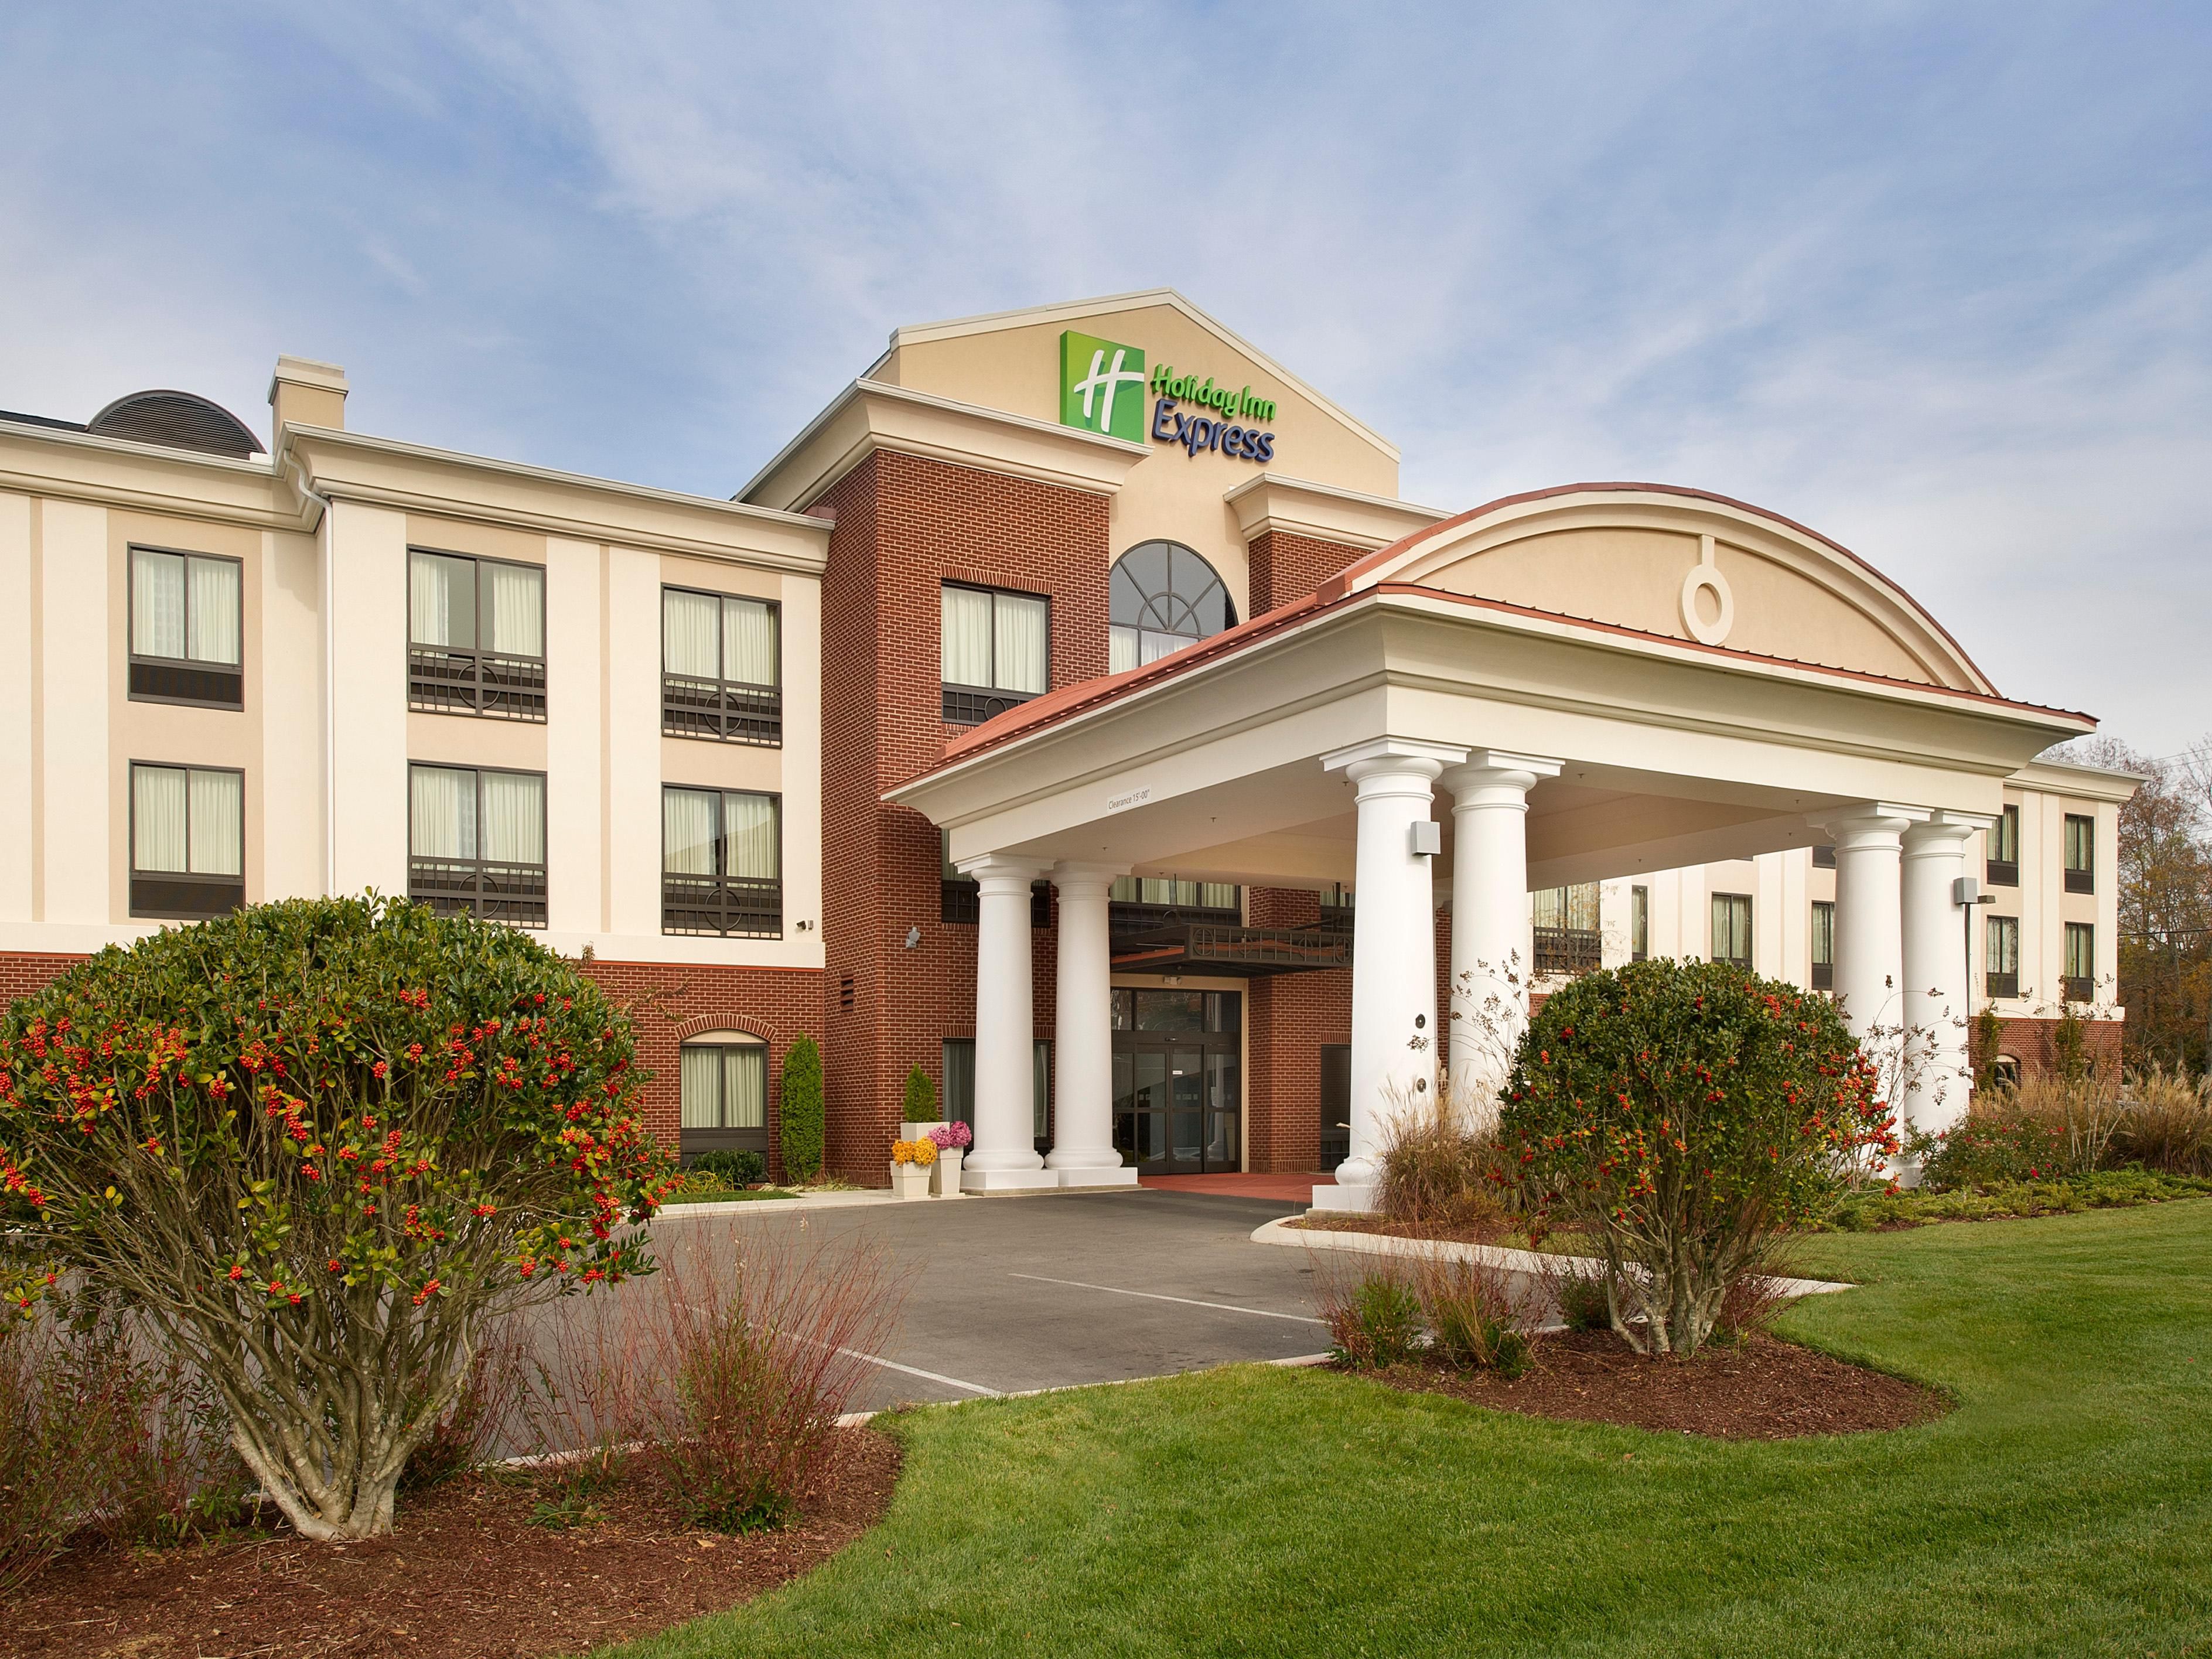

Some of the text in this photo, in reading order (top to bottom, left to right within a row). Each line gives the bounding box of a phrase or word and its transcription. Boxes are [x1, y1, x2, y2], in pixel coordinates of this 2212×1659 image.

[1151, 363, 1277, 421] Holiday Inn
[1152, 398, 1275, 462] Express
[1108, 796, 1132, 810] Clearance
